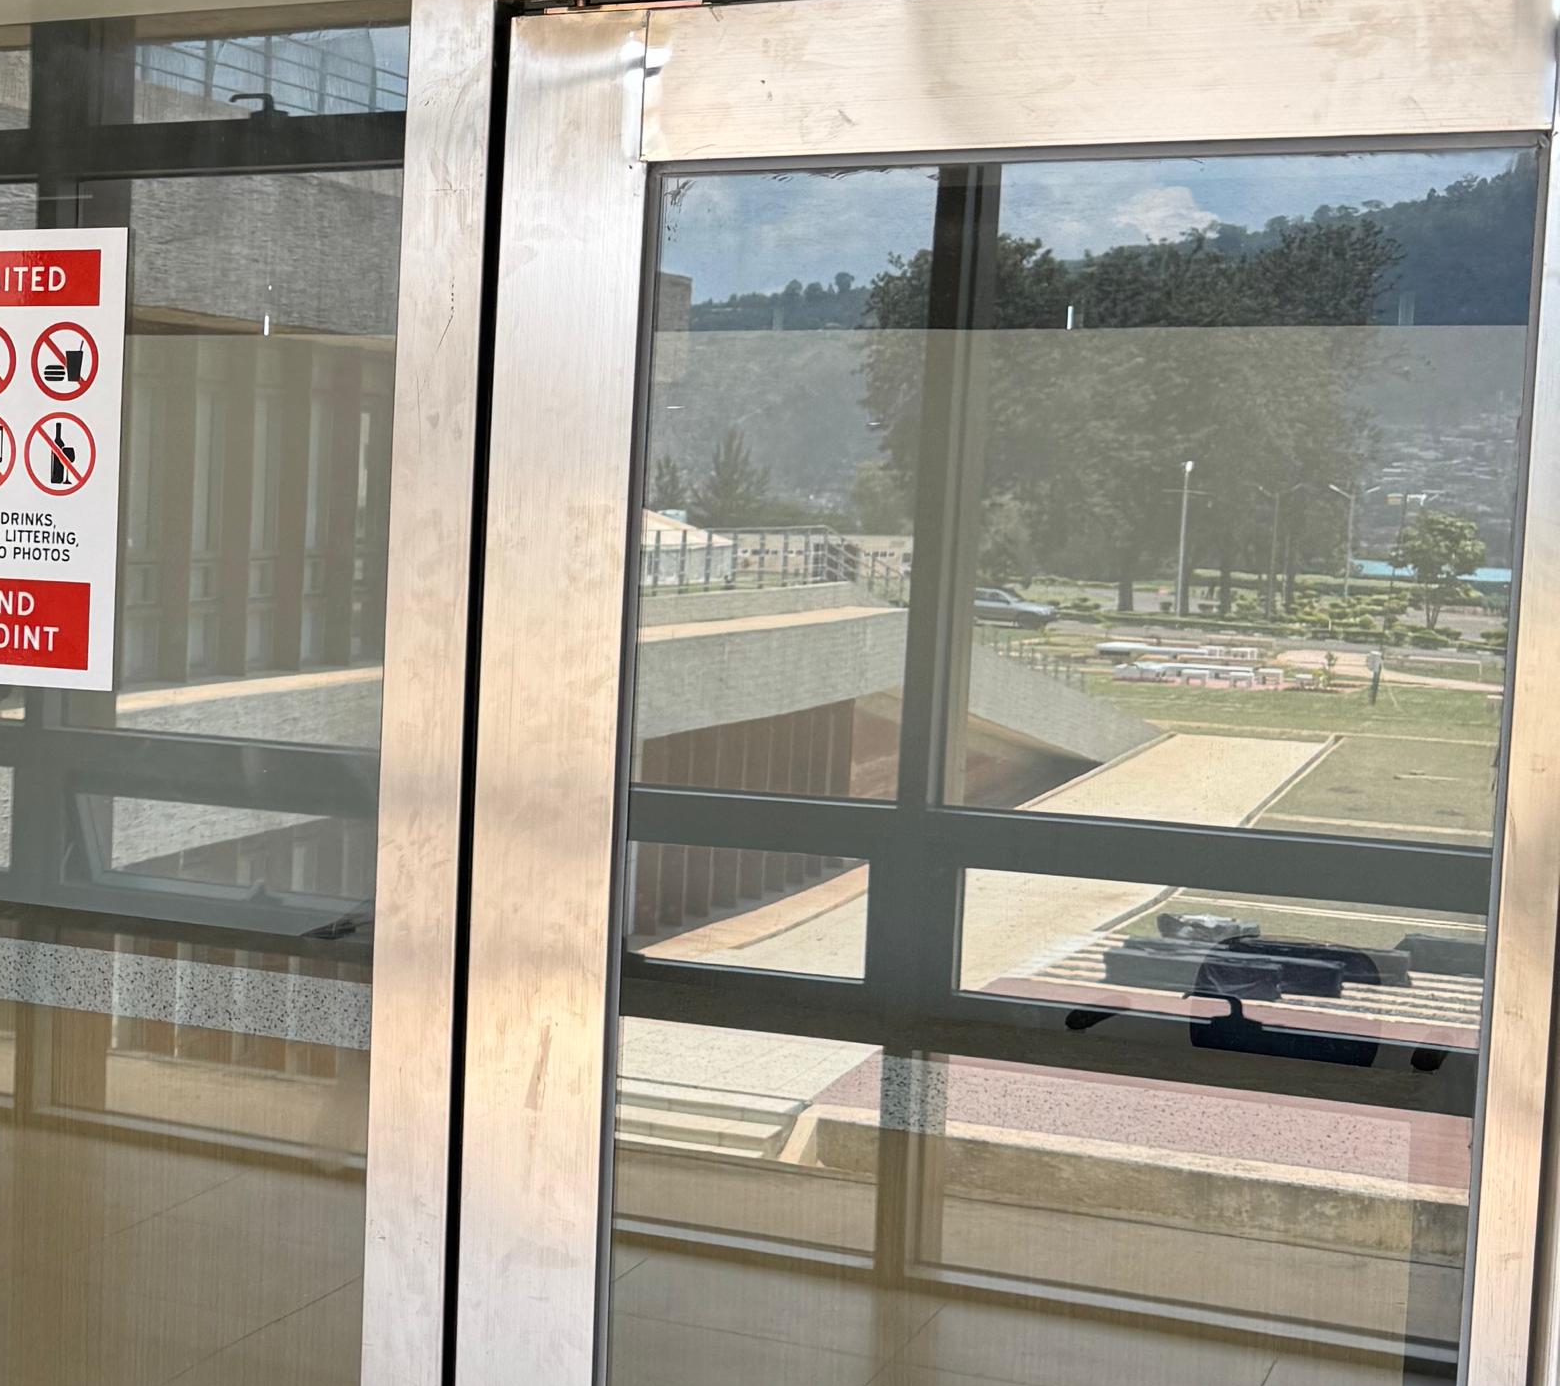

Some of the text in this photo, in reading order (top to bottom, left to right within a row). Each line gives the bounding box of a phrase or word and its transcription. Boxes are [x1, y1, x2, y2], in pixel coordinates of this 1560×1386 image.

[0, 511, 57, 529] DRINKS,
[5, 529, 80, 548] LITTERING,
[13, 546, 71, 562] PHOTOS
